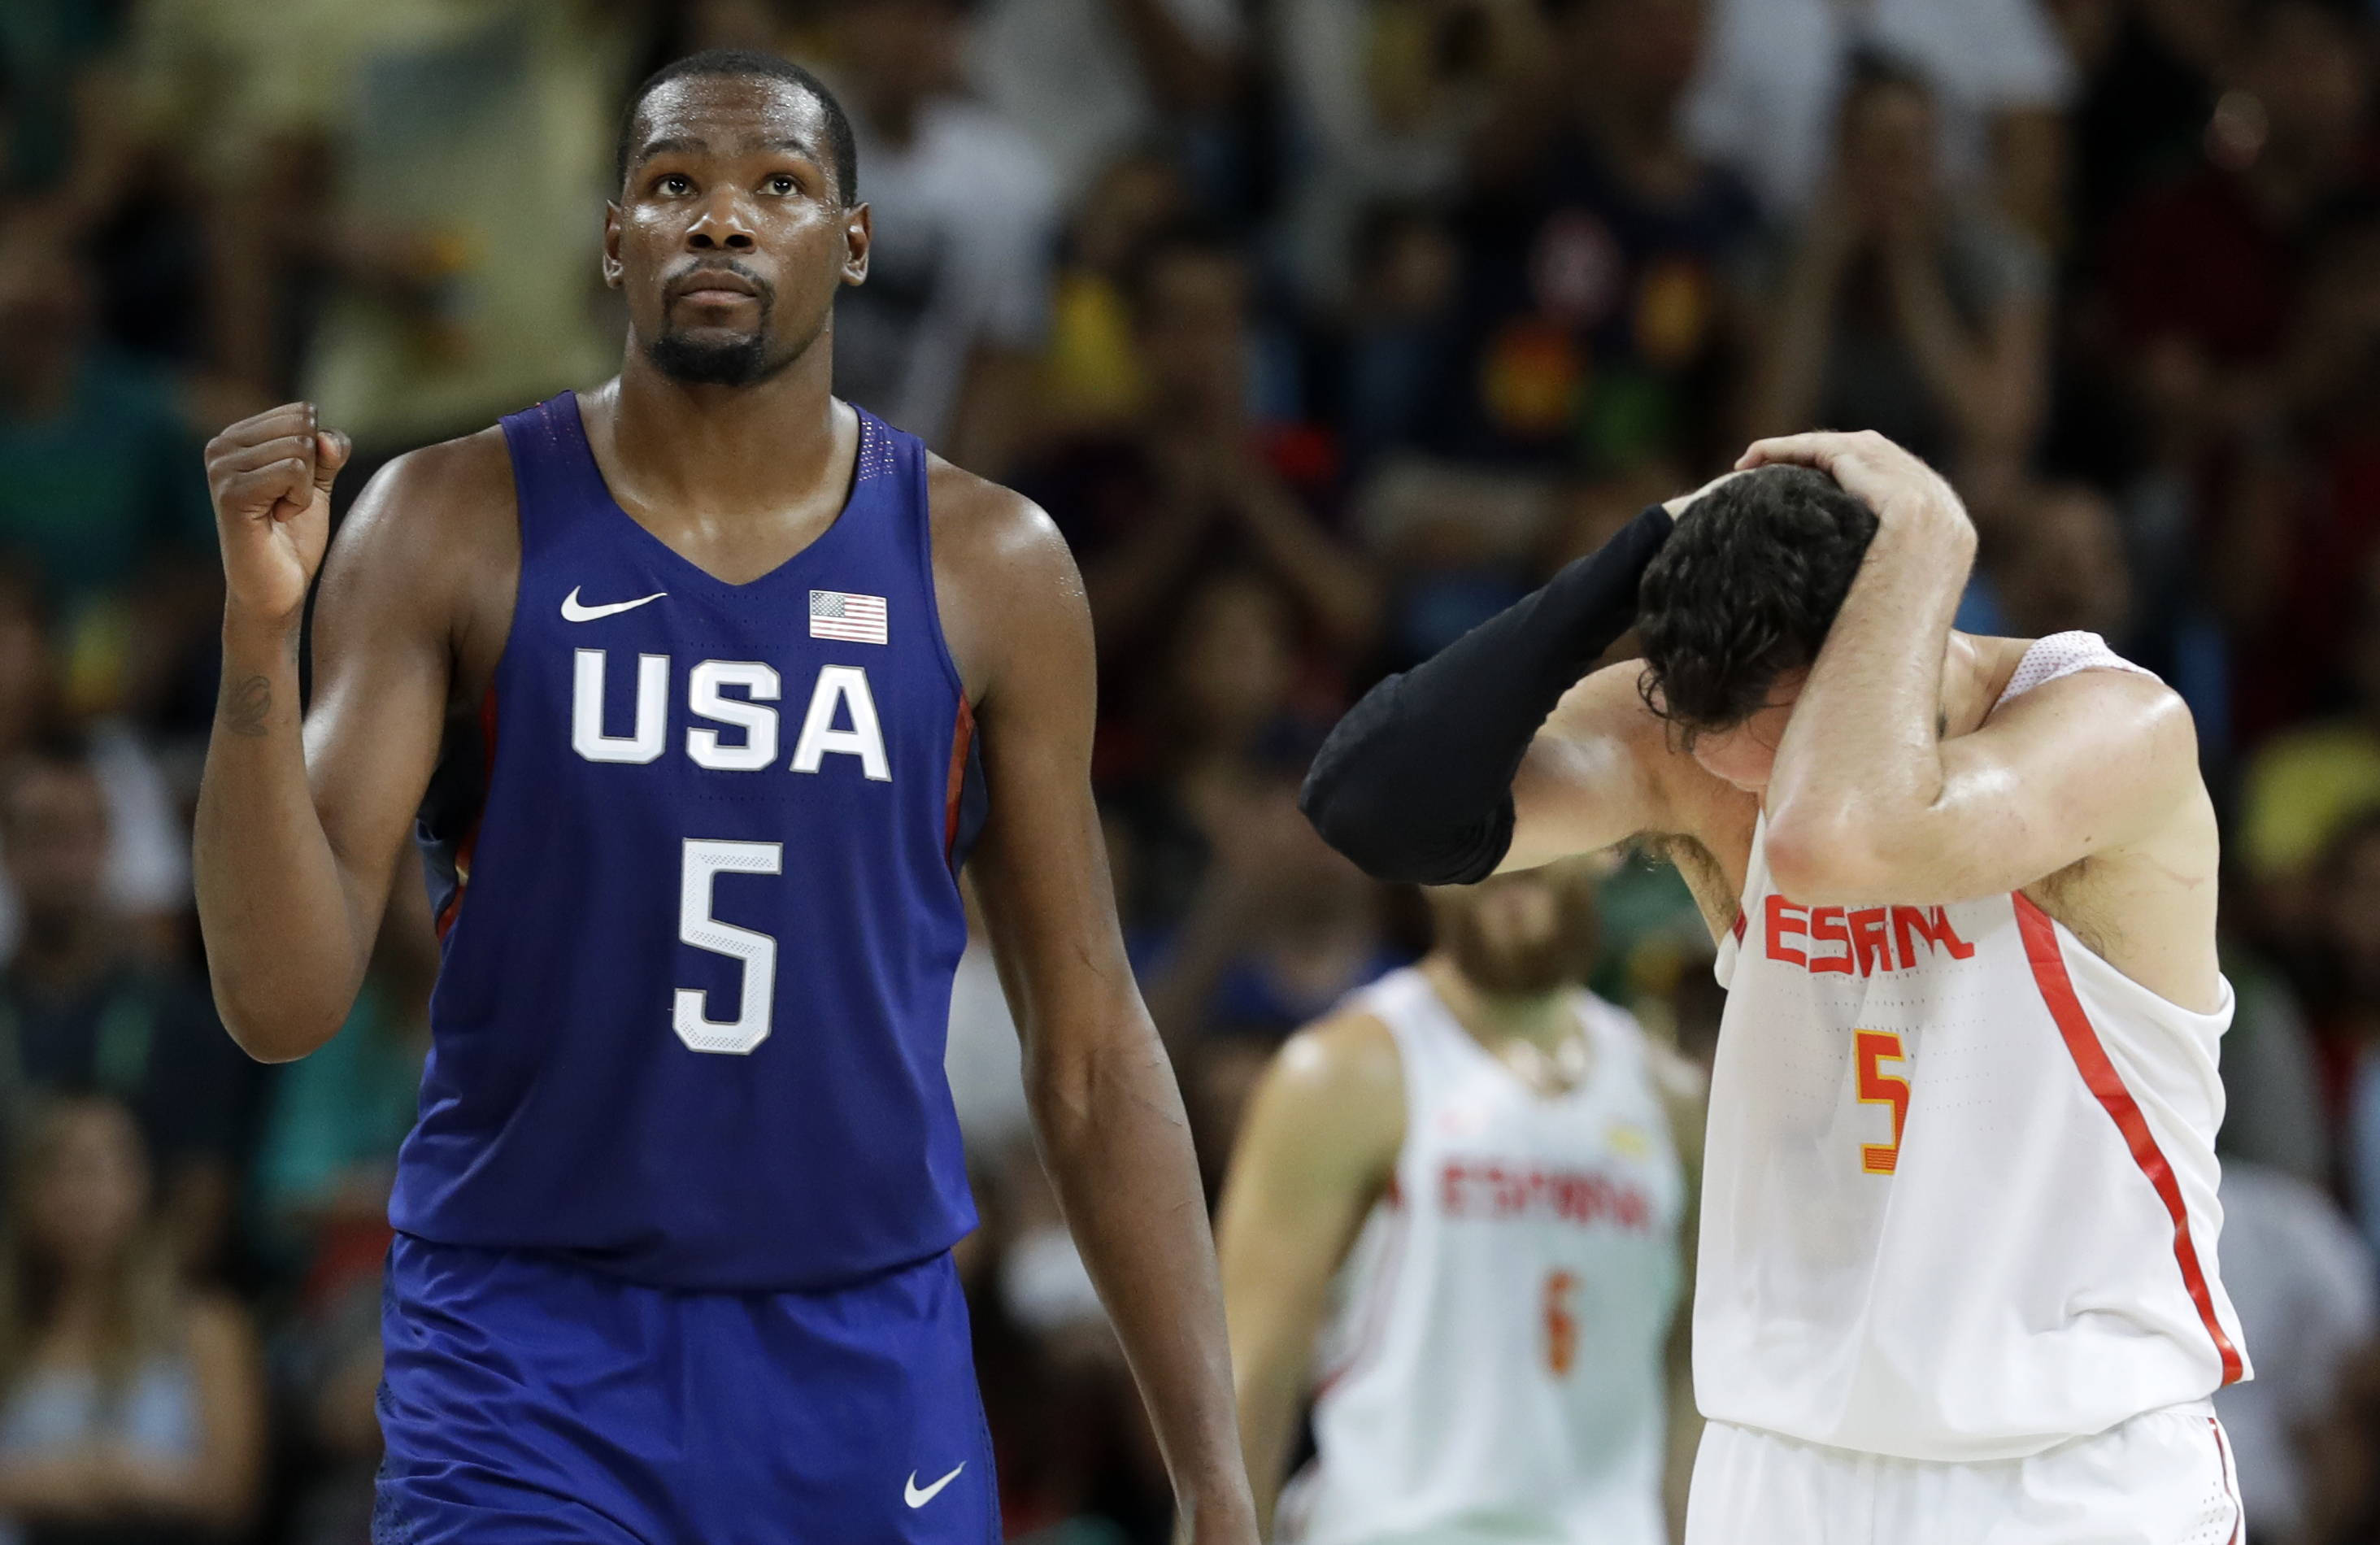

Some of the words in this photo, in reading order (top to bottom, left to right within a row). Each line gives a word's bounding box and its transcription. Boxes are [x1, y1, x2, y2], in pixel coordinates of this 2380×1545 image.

[572, 647, 892, 782] USA
[672, 838, 783, 1056] 5
[1853, 1028, 1912, 1176] 5
